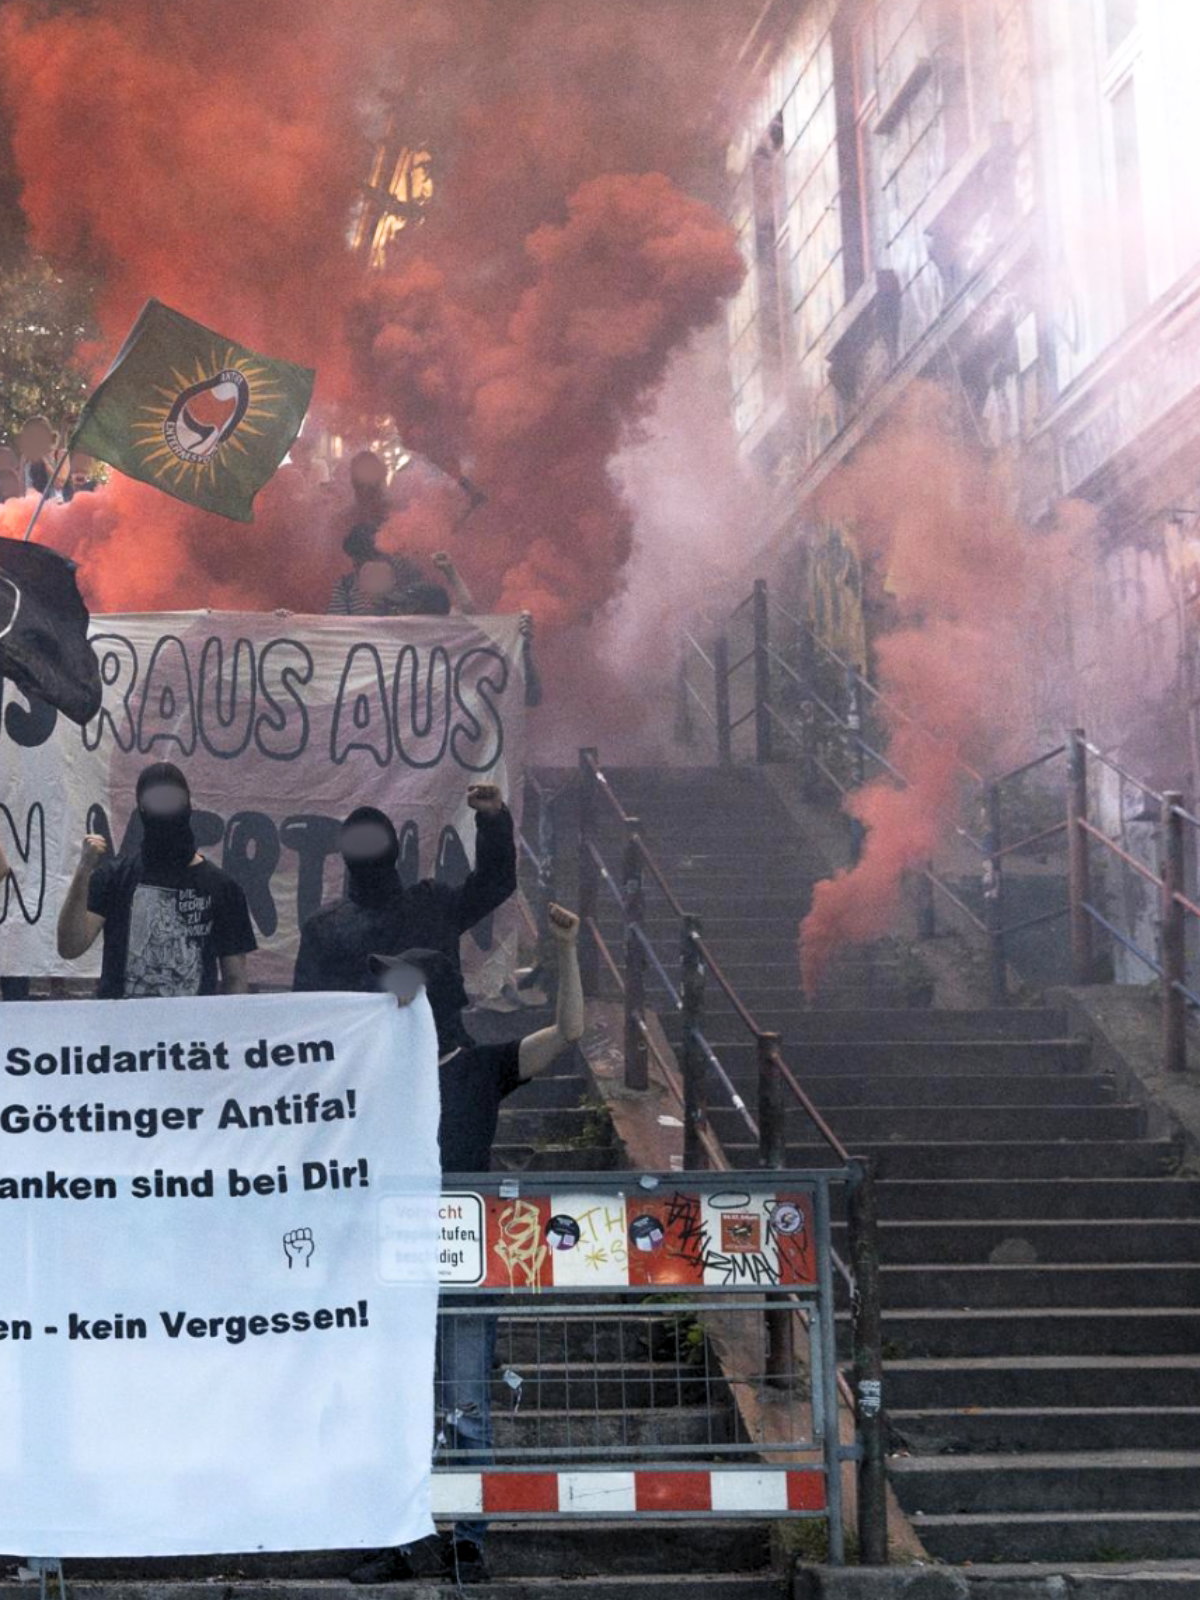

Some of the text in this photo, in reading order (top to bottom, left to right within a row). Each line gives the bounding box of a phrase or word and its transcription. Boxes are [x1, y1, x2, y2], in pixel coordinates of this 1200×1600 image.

[82, 633, 314, 761] RAUS
[330, 642, 508, 772] AUS
[4, 1041, 230, 1077] Solidarität
[244, 1039, 335, 1069] dem
[0, 1102, 204, 1139] Göttinger
[217, 1089, 356, 1130] Antifa!
[131, 1169, 214, 1199] sind
[228, 1165, 288, 1198] bei
[302, 1158, 369, 1191] Dir!
[438, 1226, 475, 1241] tufen
[44, 1326, 58, 1334] -
[68, 1313, 147, 1340] kein
[159, 1300, 369, 1345] Vergessen!
